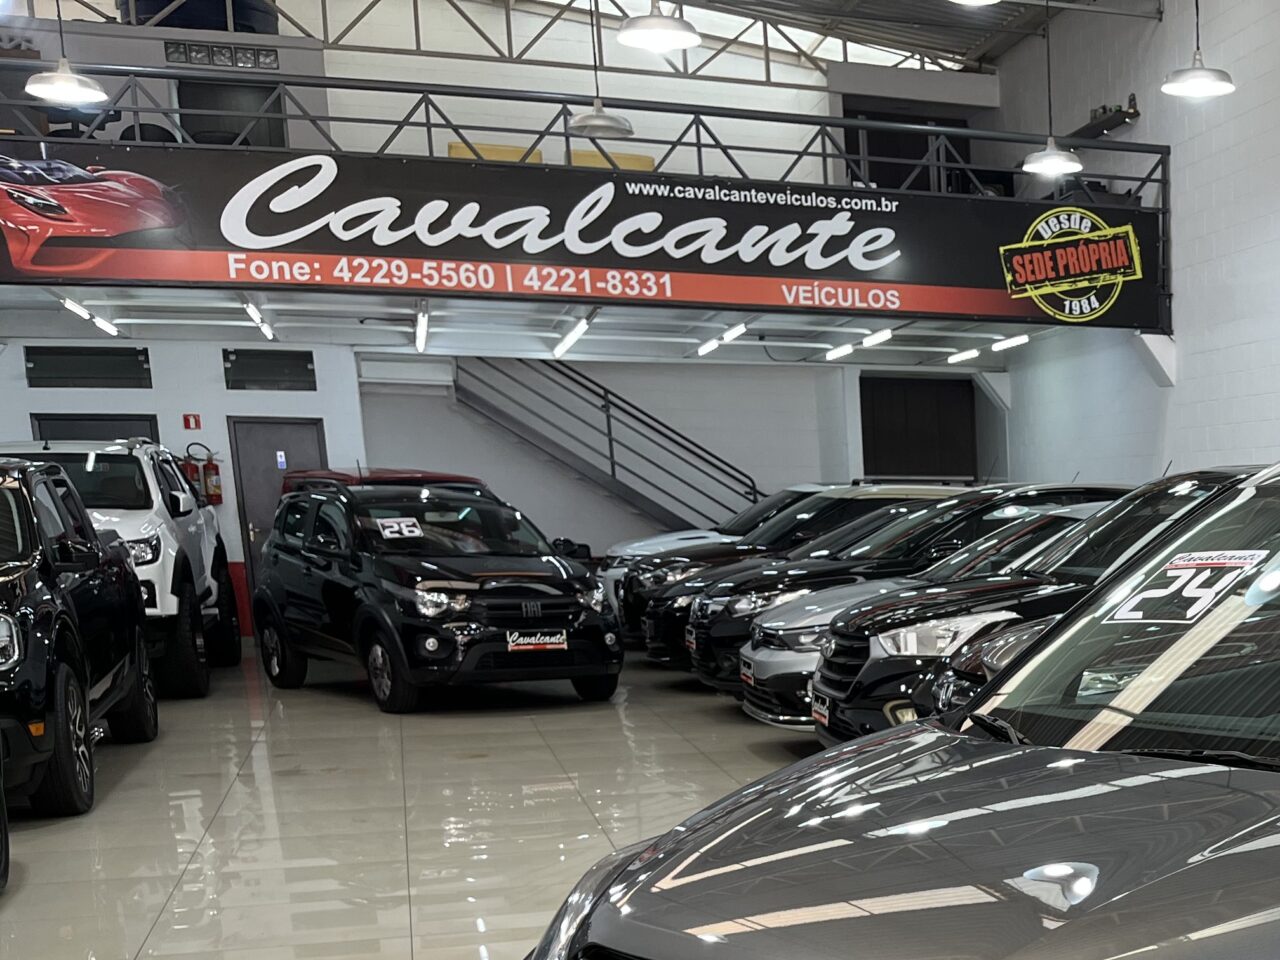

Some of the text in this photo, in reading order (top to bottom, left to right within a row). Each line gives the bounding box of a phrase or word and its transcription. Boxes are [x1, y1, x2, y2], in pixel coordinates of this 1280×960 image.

[625, 181, 900, 213] www.cavalcanteveiculos.com.br
[220, 154, 901, 271] Cavalcante
[1038, 212, 1092, 240] Desde
[227, 252, 321, 281] Fone:
[332, 256, 495, 290] 4229-5560
[523, 265, 673, 297] 4221-8331
[1012, 239, 1130, 284] SEDE PRÓPRIA
[780, 280, 901, 310] VEÍCULOS
[1063, 294, 1100, 315] 1984
[383, 521, 421, 538] 26
[1113, 567, 1243, 620] 24
[521, 601, 542, 618] FIAT
[509, 631, 567, 645] Cavalcante
